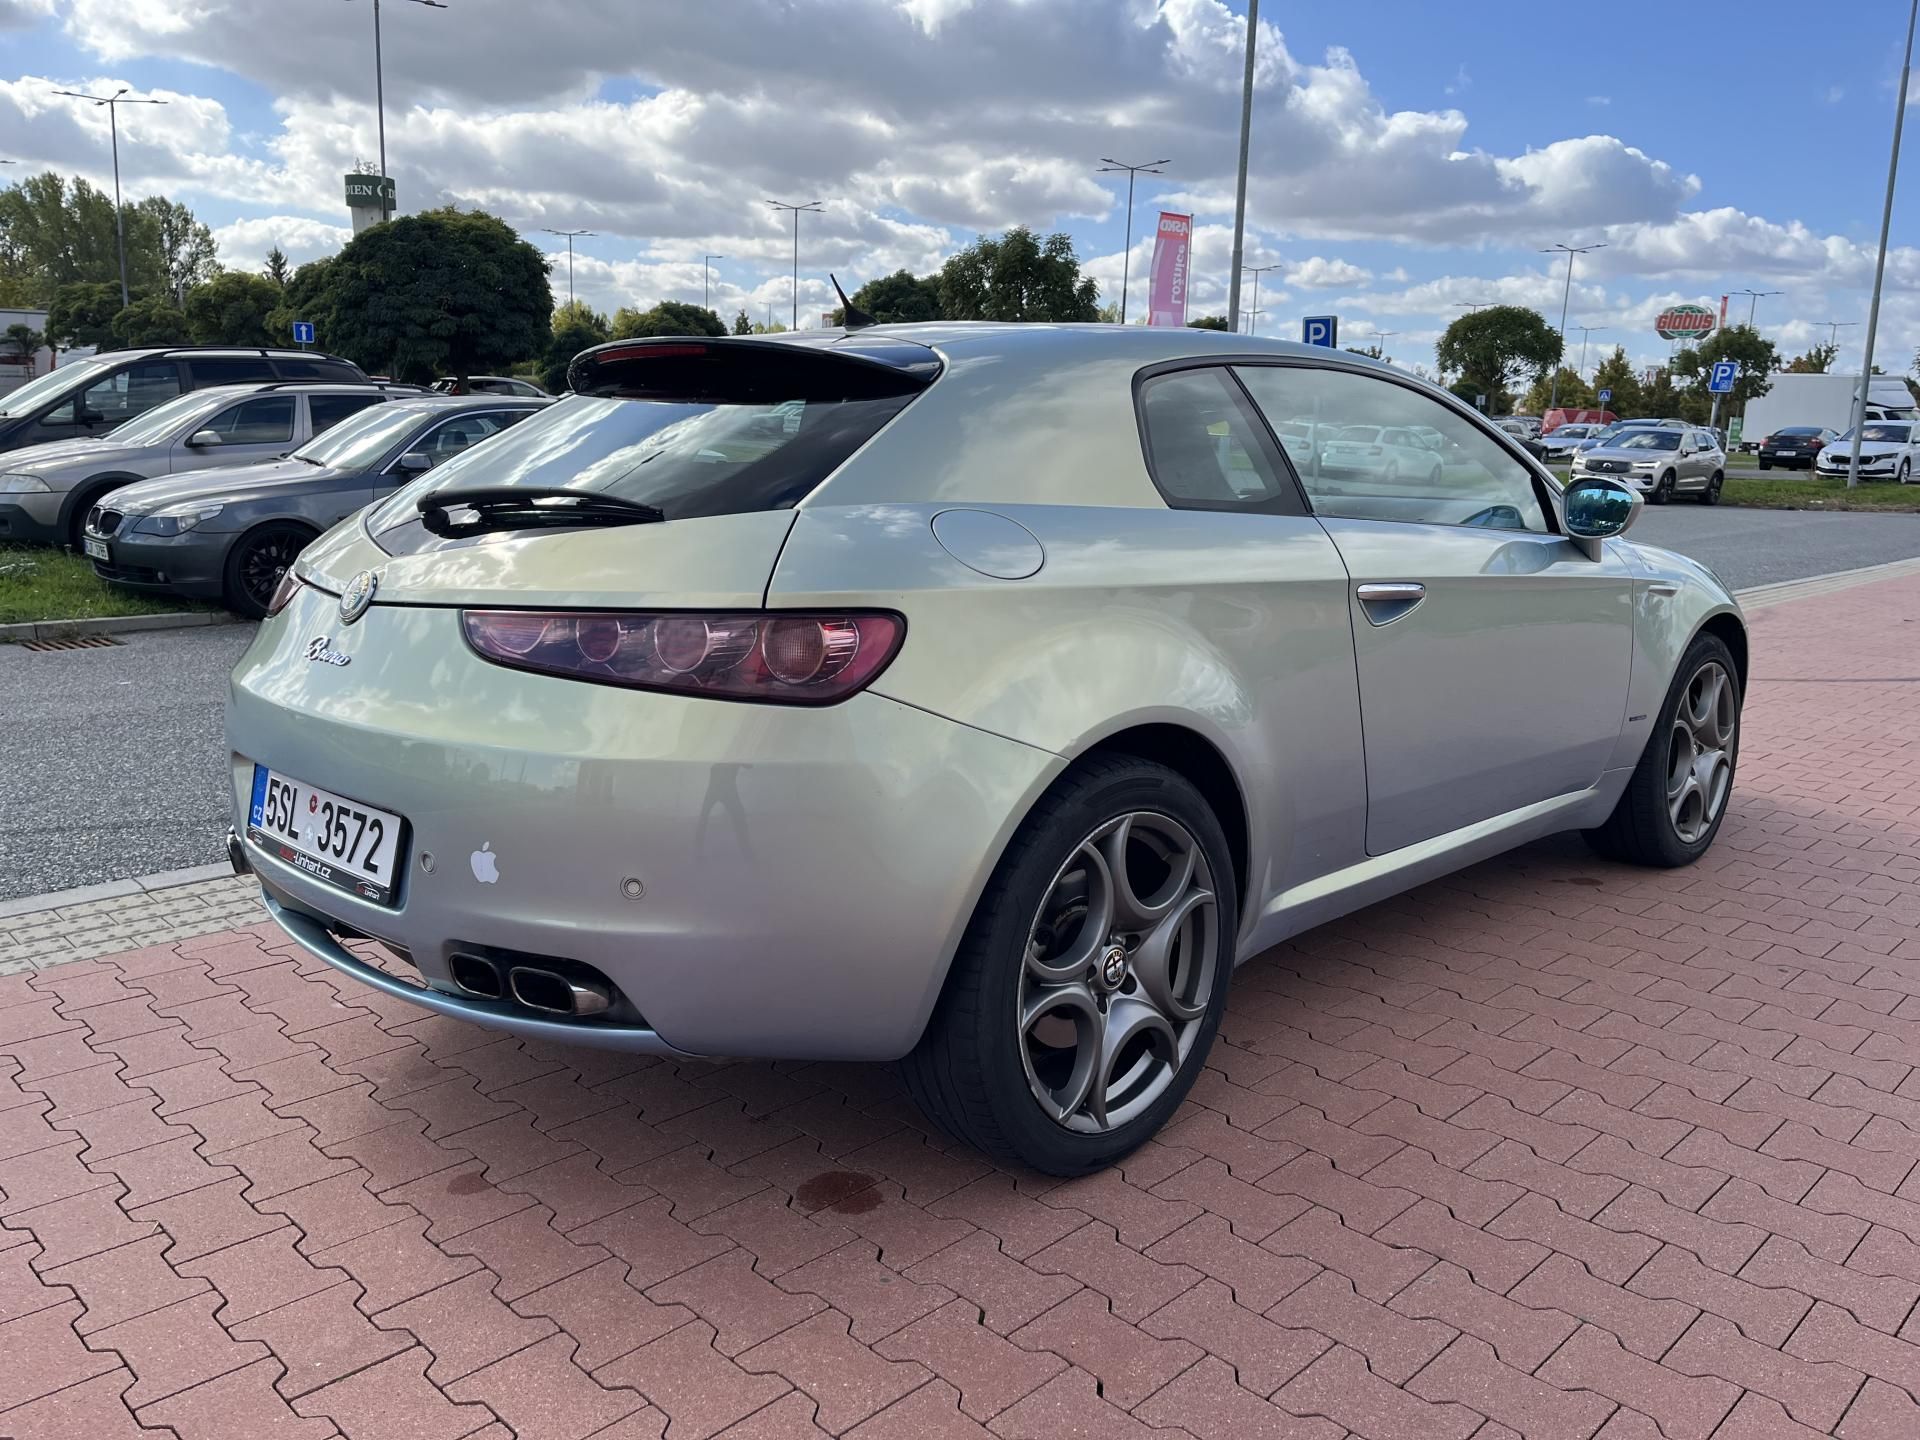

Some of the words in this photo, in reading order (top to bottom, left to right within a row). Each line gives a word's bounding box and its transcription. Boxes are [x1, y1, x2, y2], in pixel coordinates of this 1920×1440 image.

[1309, 323, 1326, 344] P
[1715, 365, 1731, 384] P
[253, 804, 263, 822] CZ
[266, 778, 299, 840] 5SL
[317, 801, 384, 875] 3572
